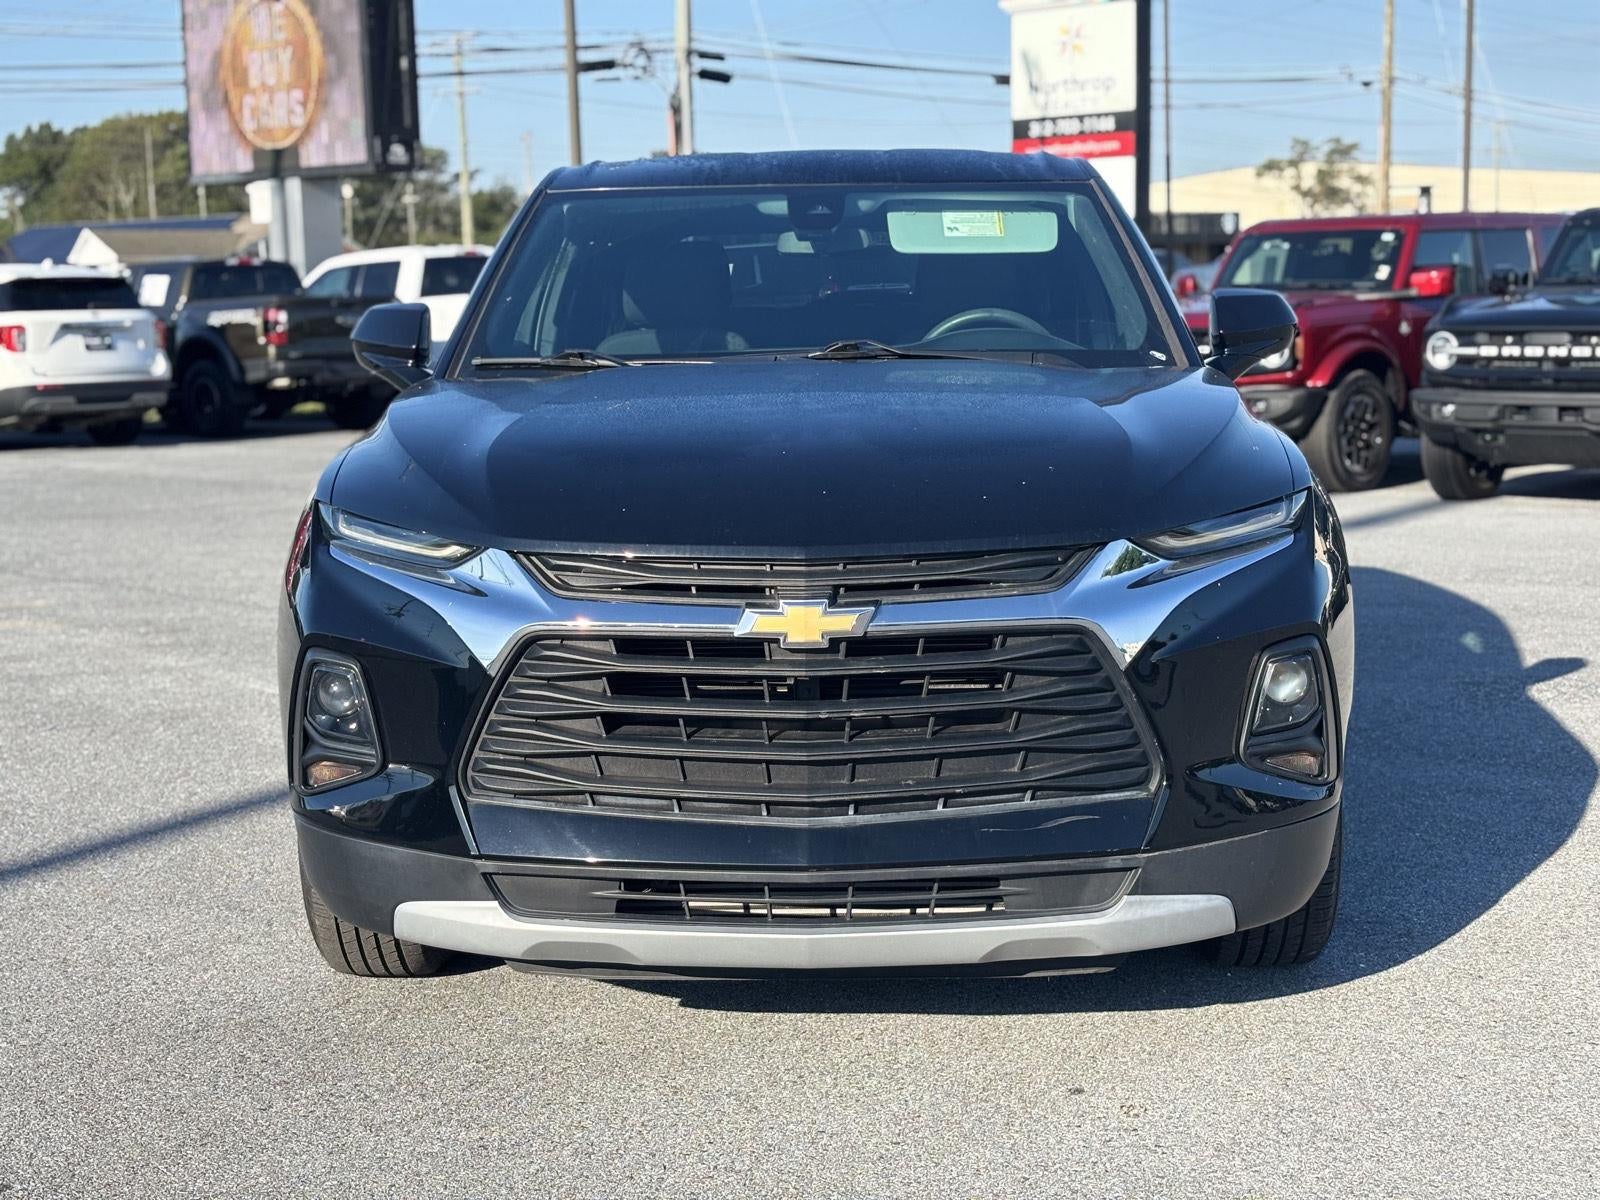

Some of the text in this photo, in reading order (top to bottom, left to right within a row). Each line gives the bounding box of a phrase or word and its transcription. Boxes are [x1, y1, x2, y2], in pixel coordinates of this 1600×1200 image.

[247, 45, 294, 89] BUY
[242, 88, 305, 131] CARS
[1478, 345, 1600, 357] BRONC
